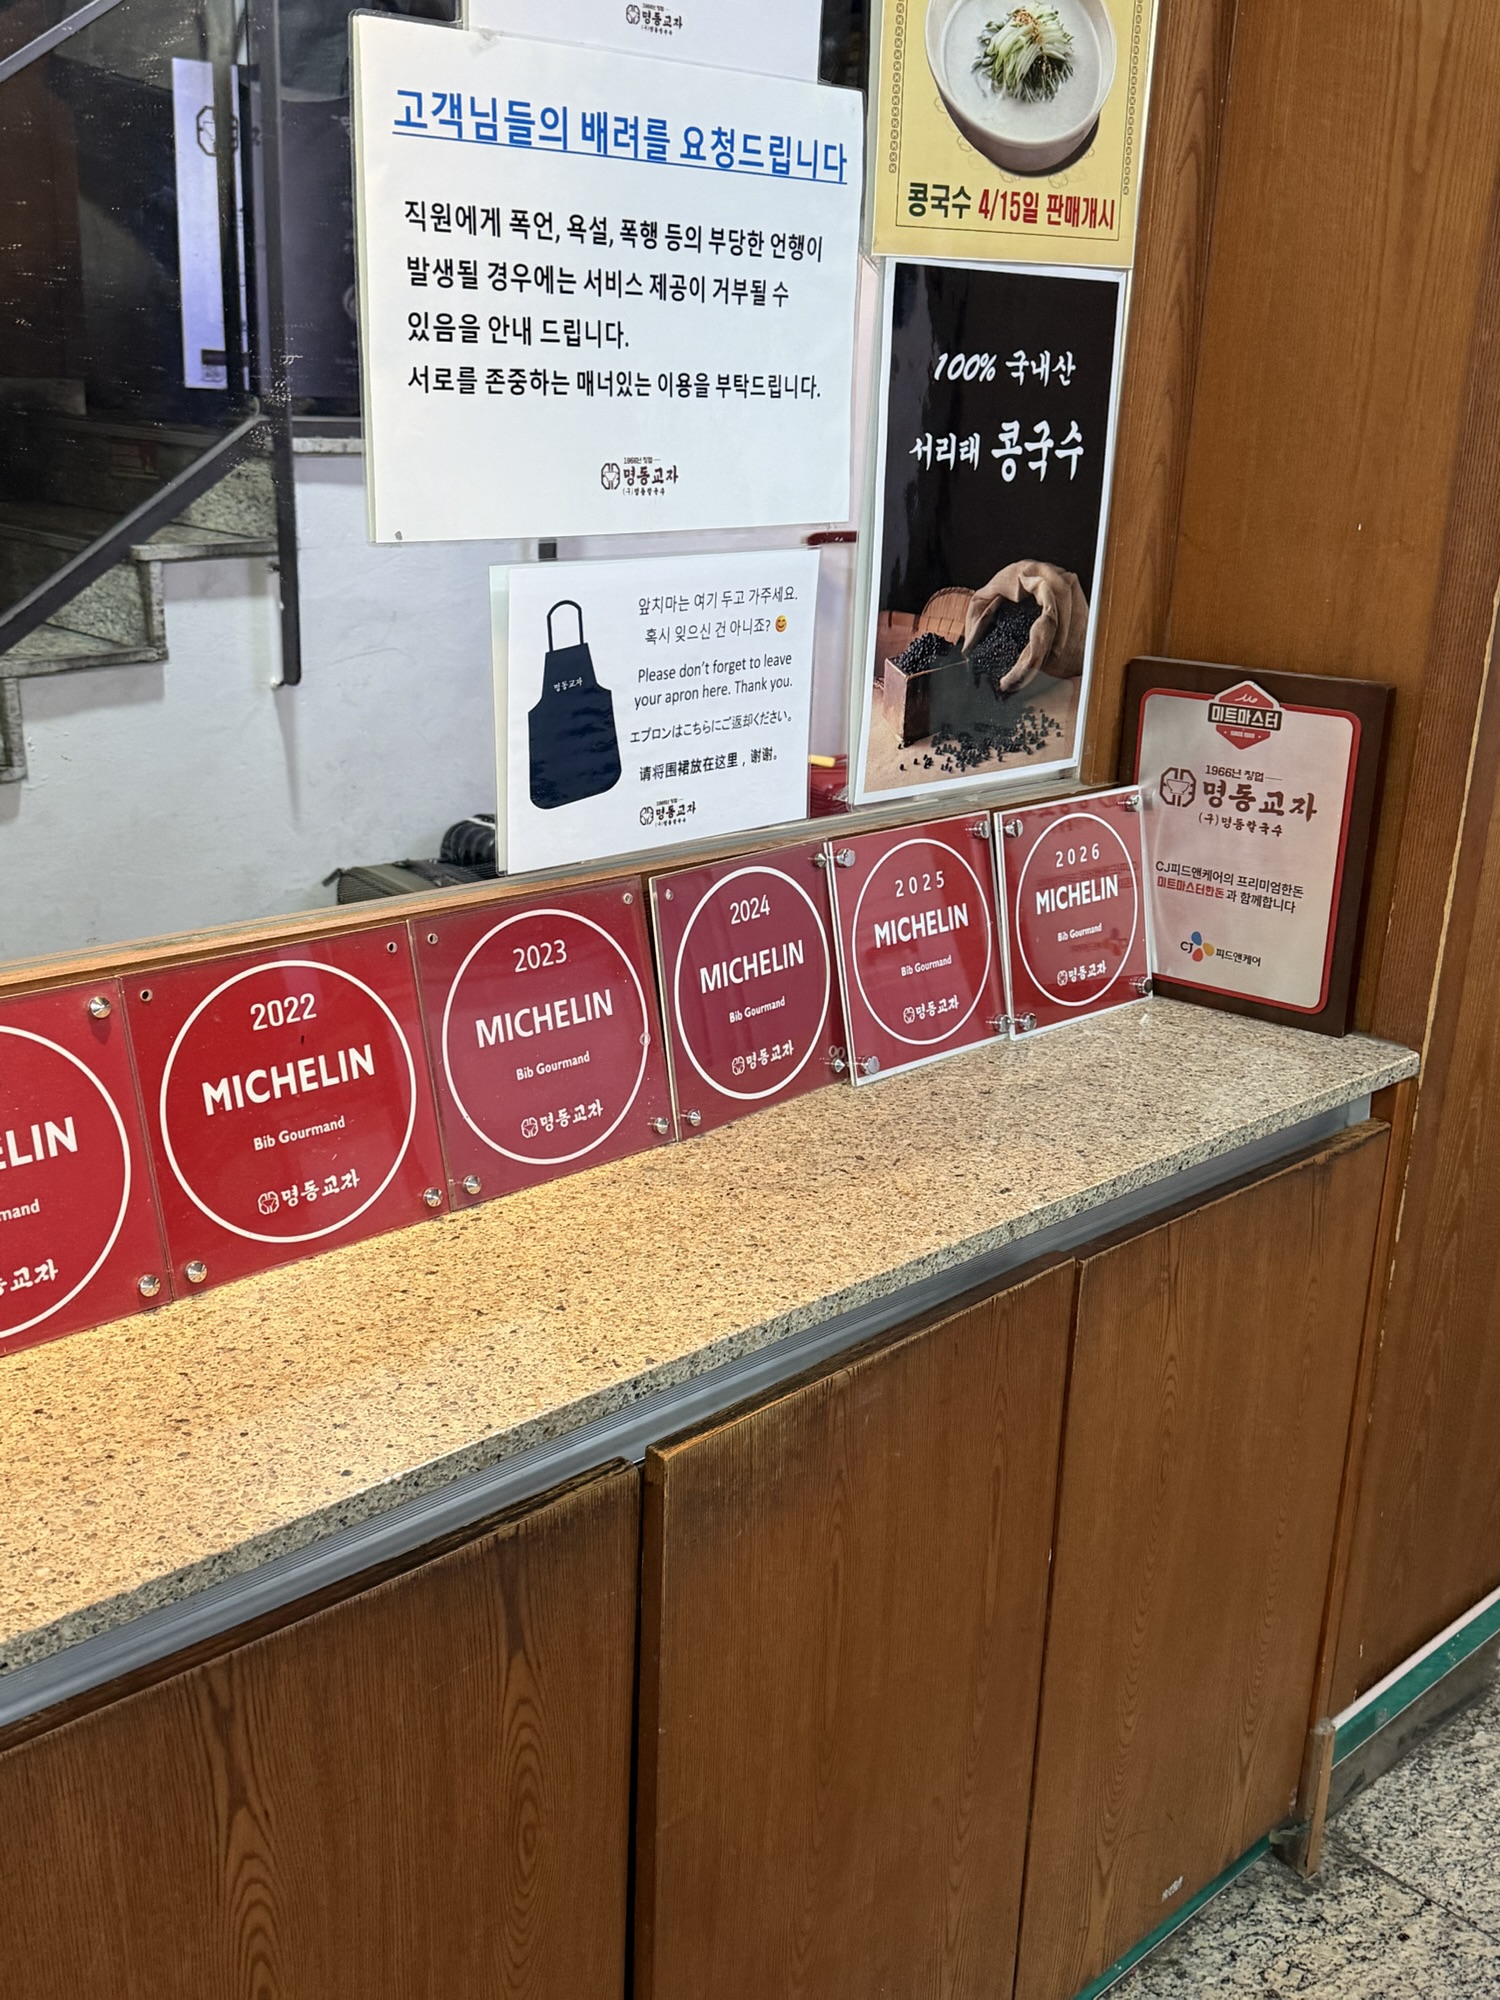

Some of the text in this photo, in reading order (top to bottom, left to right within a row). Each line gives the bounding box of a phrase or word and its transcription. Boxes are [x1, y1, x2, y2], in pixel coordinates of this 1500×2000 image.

[394, 89, 848, 182] 고객님들의 배려를 요청드립니다
[908, 182, 1115, 230] 콩국수 4/15일 판매개시
[405, 200, 823, 263] 직원에게 폭언, 욕설, 폭행 등의 부당한 언행이
[407, 256, 789, 307] 발생될 경우에는 서비스 제공이 거부될 수
[408, 311, 629, 349] 있음을 안내 드립니다.
[408, 365, 821, 399] 서로를 존중하는 매너있는 이용을 부탁드립니다.
[934, 350, 1076, 387] 100% 국내산
[909, 419, 1084, 483] 서리태 콩국수
[623, 465, 679, 486] 명동교자
[638, 586, 798, 615] 앞치마는 여기 두고 가주세요.
[645, 617, 771, 645] 혹시 잊으신 건 아니죠?
[638, 653, 792, 683] Please don’t forget to leave
[634, 676, 793, 710] your apron here. Thank you.
[630, 710, 792, 743] エプロンはこちらにご返却ください。
[1211, 705, 1279, 728] 미트마스터
[1205, 764, 1265, 783] 1966년 창업
[655, 800, 697, 820] 명동교자
[1202, 779, 1318, 822] 명동교자
[1055, 843, 1100, 868] 2026
[895, 870, 945, 897] 2025
[1036, 874, 1119, 915] MICHELIN
[1155, 861, 1304, 899] CJ피드앤케어의 프리미엄한돈
[729, 894, 771, 925] 2024
[1240, 891, 1296, 913] 함께합니다
[874, 903, 969, 949] MICHELIN
[1057, 923, 1102, 942] Bib Gourmand
[512, 939, 567, 973] 2023
[699, 939, 805, 994] MICHELIN
[901, 954, 952, 977] Bib Gourmand
[1180, 941, 1262, 967] CJ 피드앤케어
[1068, 960, 1107, 983] 명동교자
[250, 993, 317, 1031] 2022
[475, 988, 614, 1048] MICHELIN
[729, 996, 785, 1023] Bib Gourmand
[915, 994, 960, 1020] 명동교자
[516, 1051, 590, 1081] Bib Gourmand
[746, 1039, 794, 1070] 명동교자
[201, 1043, 375, 1116] MICHELIN
[540, 1098, 604, 1132] 명동교자
[253, 1115, 346, 1151] Bib Gourmand
[282, 1168, 361, 1207] 명동교자
